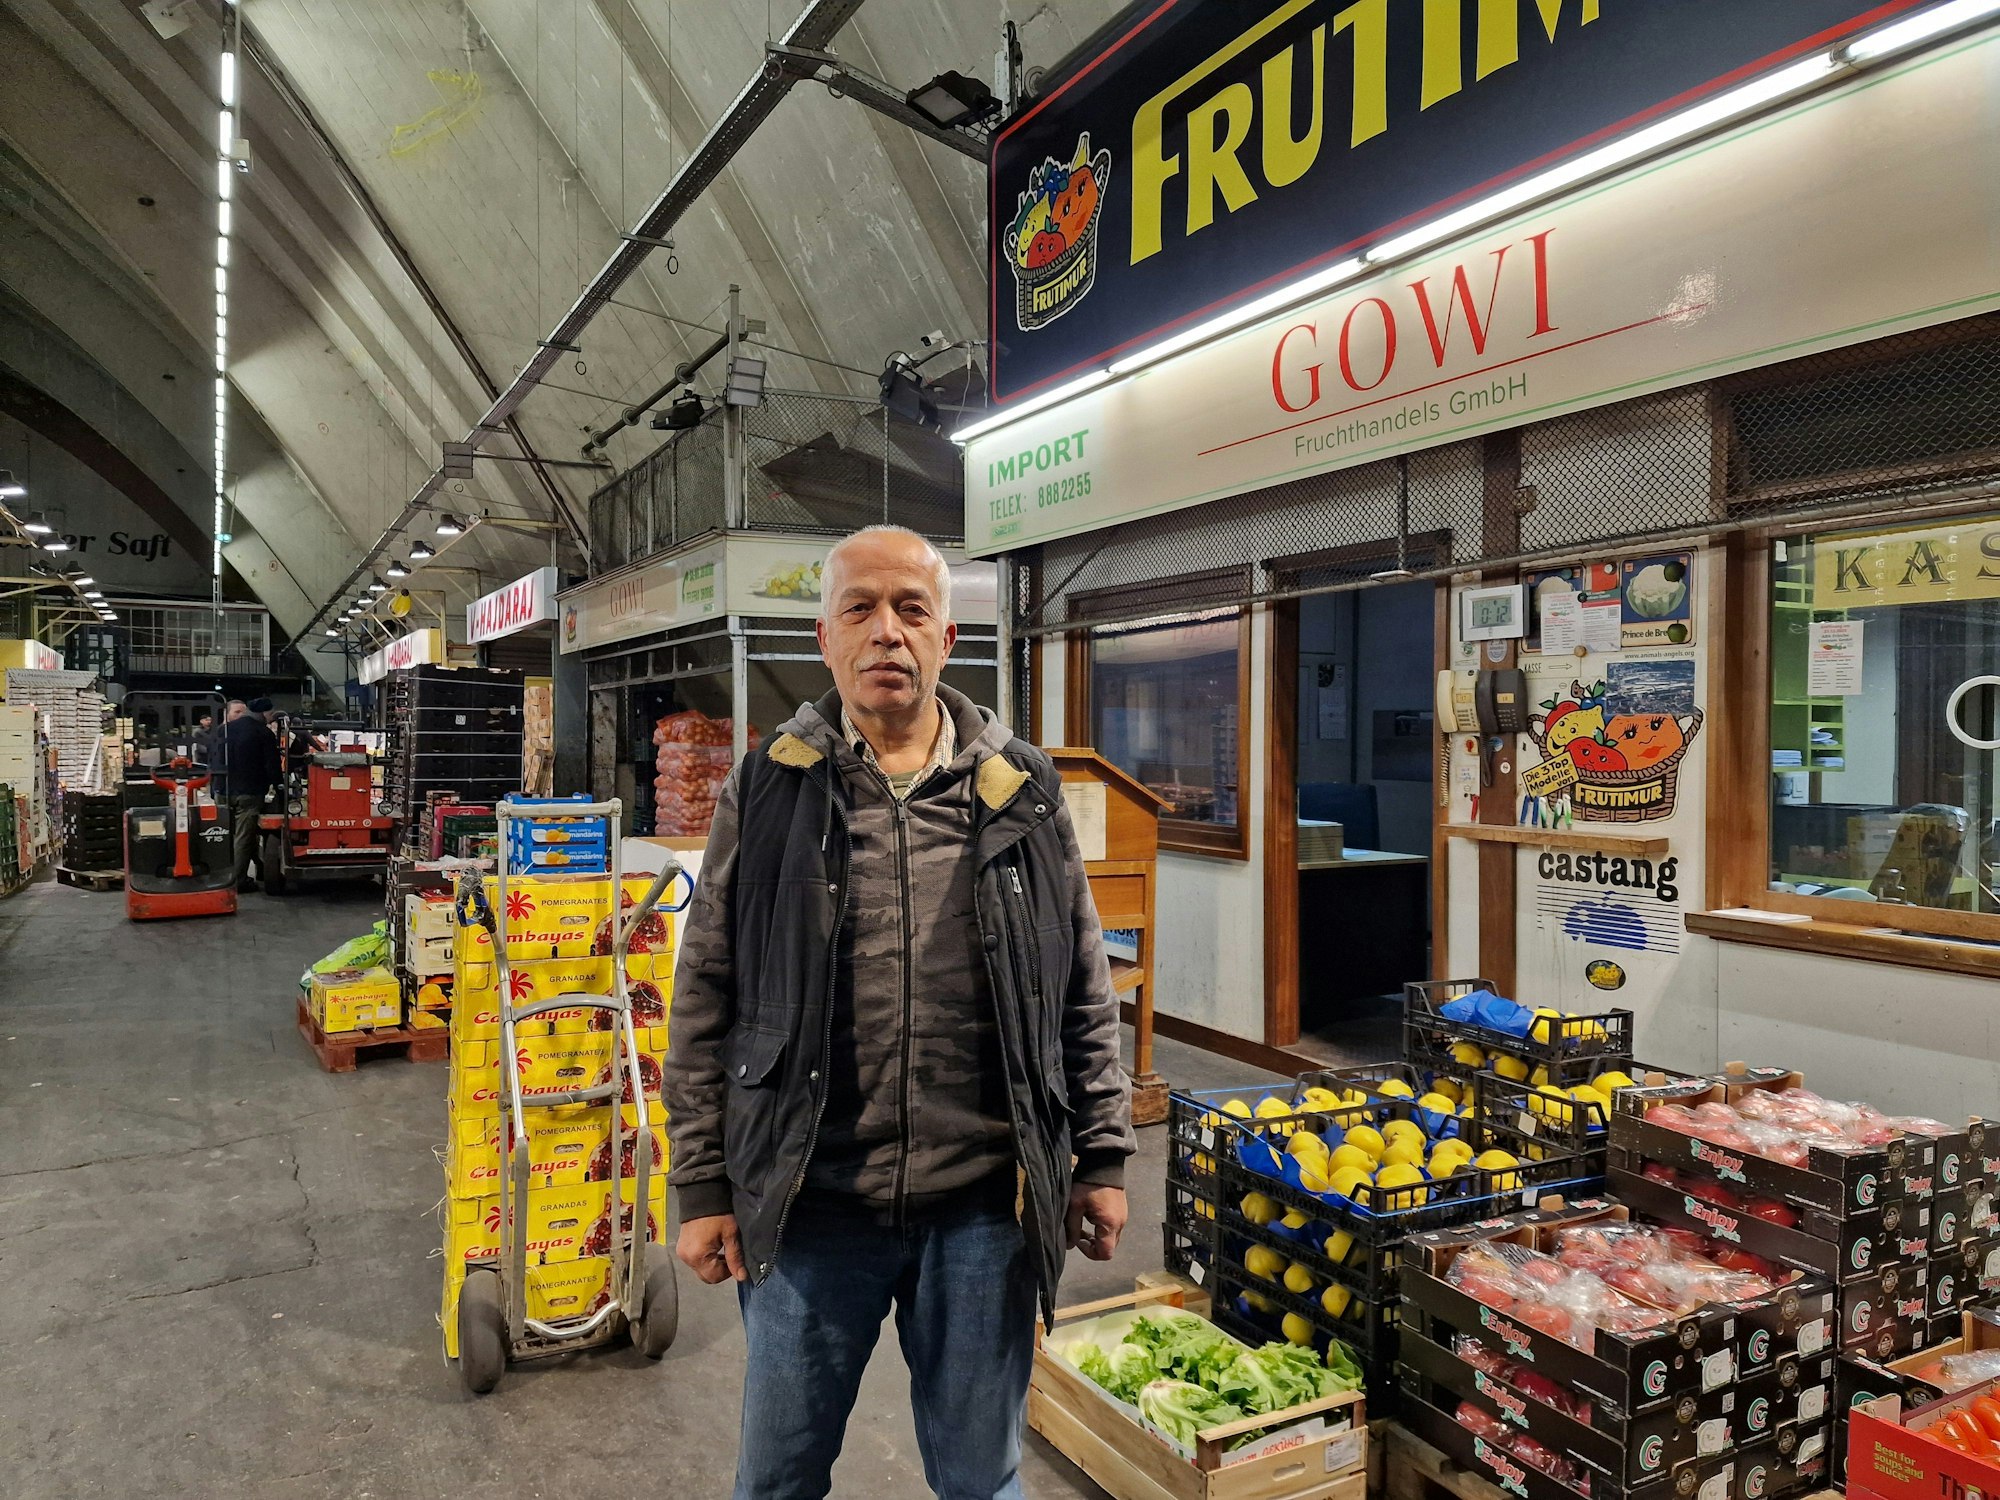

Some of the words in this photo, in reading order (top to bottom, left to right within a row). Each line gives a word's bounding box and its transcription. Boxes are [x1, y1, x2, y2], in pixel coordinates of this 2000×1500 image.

[1033, 248, 1088, 314] FRUTIMUR
[1272, 227, 1560, 413] GOWI
[1295, 400, 1440, 457] Fruchthandels
[1449, 372, 1527, 416] GmbH
[988, 428, 1089, 488] IMPORT
[989, 493, 1027, 521] TELEX:
[1038, 471, 1091, 509] 8882255
[107, 531, 170, 562] Saft
[470, 577, 535, 641] V-HAJDARAJ
[610, 576, 644, 618] GOWI
[1622, 630, 1644, 638] Prince
[1645, 629, 1654, 637] de
[1624, 650, 1695, 659] www.animals-angels.org
[1524, 662, 1542, 674] KASSE
[1526, 769, 1541, 783] Die
[1541, 765, 1551, 776] 3
[1550, 757, 1569, 770] Top
[1529, 767, 1571, 792] Modelle
[1556, 775, 1574, 788] von
[1575, 780, 1663, 807] FRUTIMUR
[199, 826, 230, 836] Linde
[1538, 850, 1679, 903] castang
[541, 897, 608, 906] POMEGRANATES
[476, 930, 585, 945] Cmbayas
[549, 974, 596, 982] GRANADAS
[473, 1009, 583, 1024] Caayas
[538, 1048, 605, 1060] POMEGRANATES
[472, 1083, 581, 1101] Cabayas
[535, 1122, 602, 1136] POMEGRANATES
[469, 1158, 579, 1179] Caayas
[1698, 1146, 1744, 1172] Enjoy
[540, 1199, 588, 1212] GRANADAS
[1692, 1202, 1738, 1232] Enjoy
[464, 1236, 573, 1260] Caayas
[530, 1274, 598, 1292] POMEGRANATES
[1487, 1313, 1532, 1350] Enjoy
[1481, 1379, 1527, 1416] Enjoy
[1480, 1445, 1526, 1486] Enjoy
[1874, 1440, 1898, 1460] Best
[1900, 1452, 1916, 1466] for
[1873, 1452, 1903, 1471] soups
[1904, 1466, 1924, 1480] and
[1873, 1462, 1910, 1483] sauces
